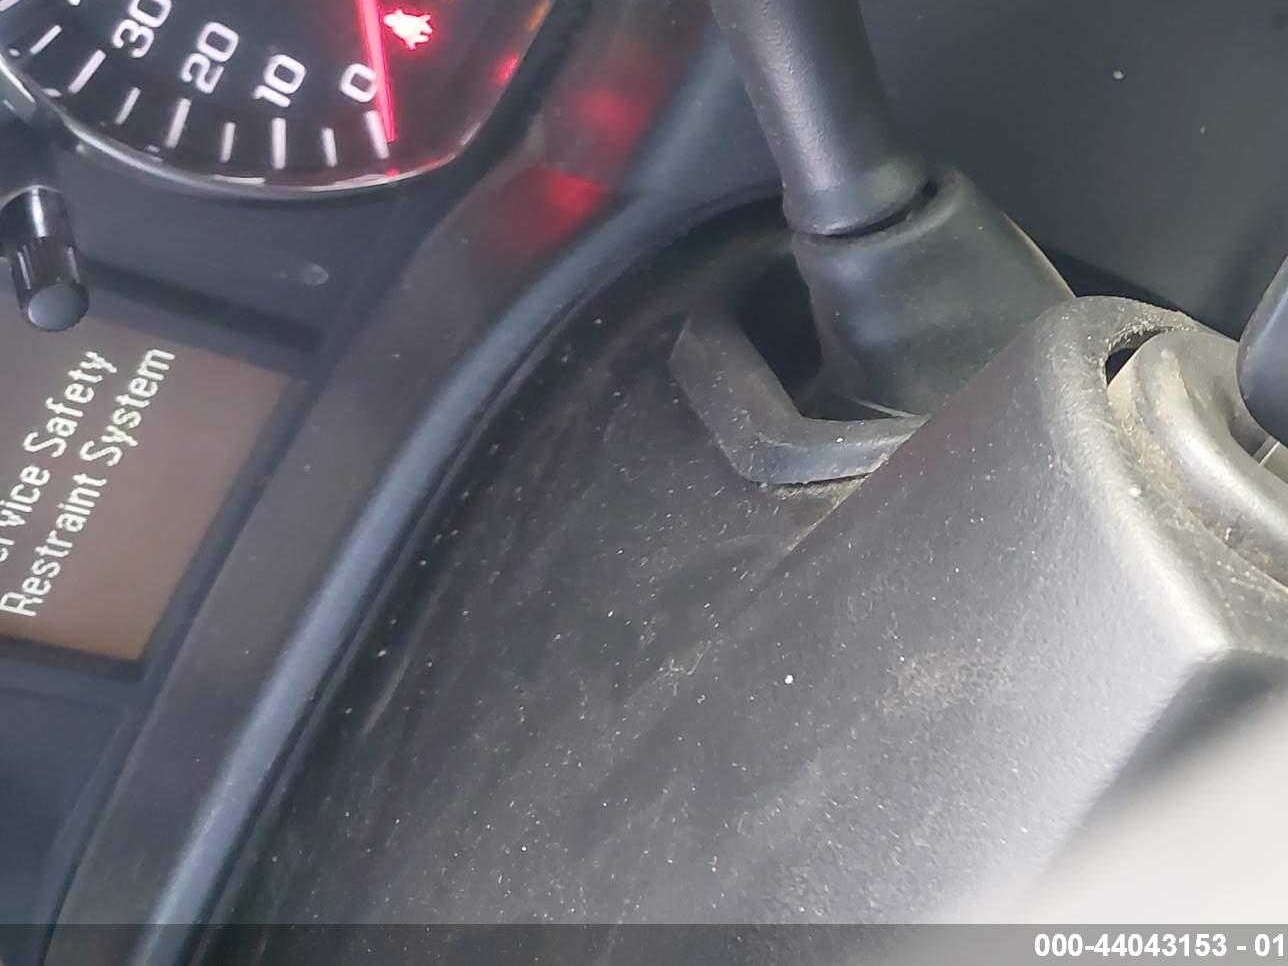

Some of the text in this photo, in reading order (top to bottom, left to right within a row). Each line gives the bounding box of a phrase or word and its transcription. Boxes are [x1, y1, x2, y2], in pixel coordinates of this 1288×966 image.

[180, 21, 239, 94] 20
[254, 54, 306, 108] 10
[341, 62, 378, 103] 0
[22, 349, 118, 458] Safety
[0, 347, 176, 618] Restraint System
